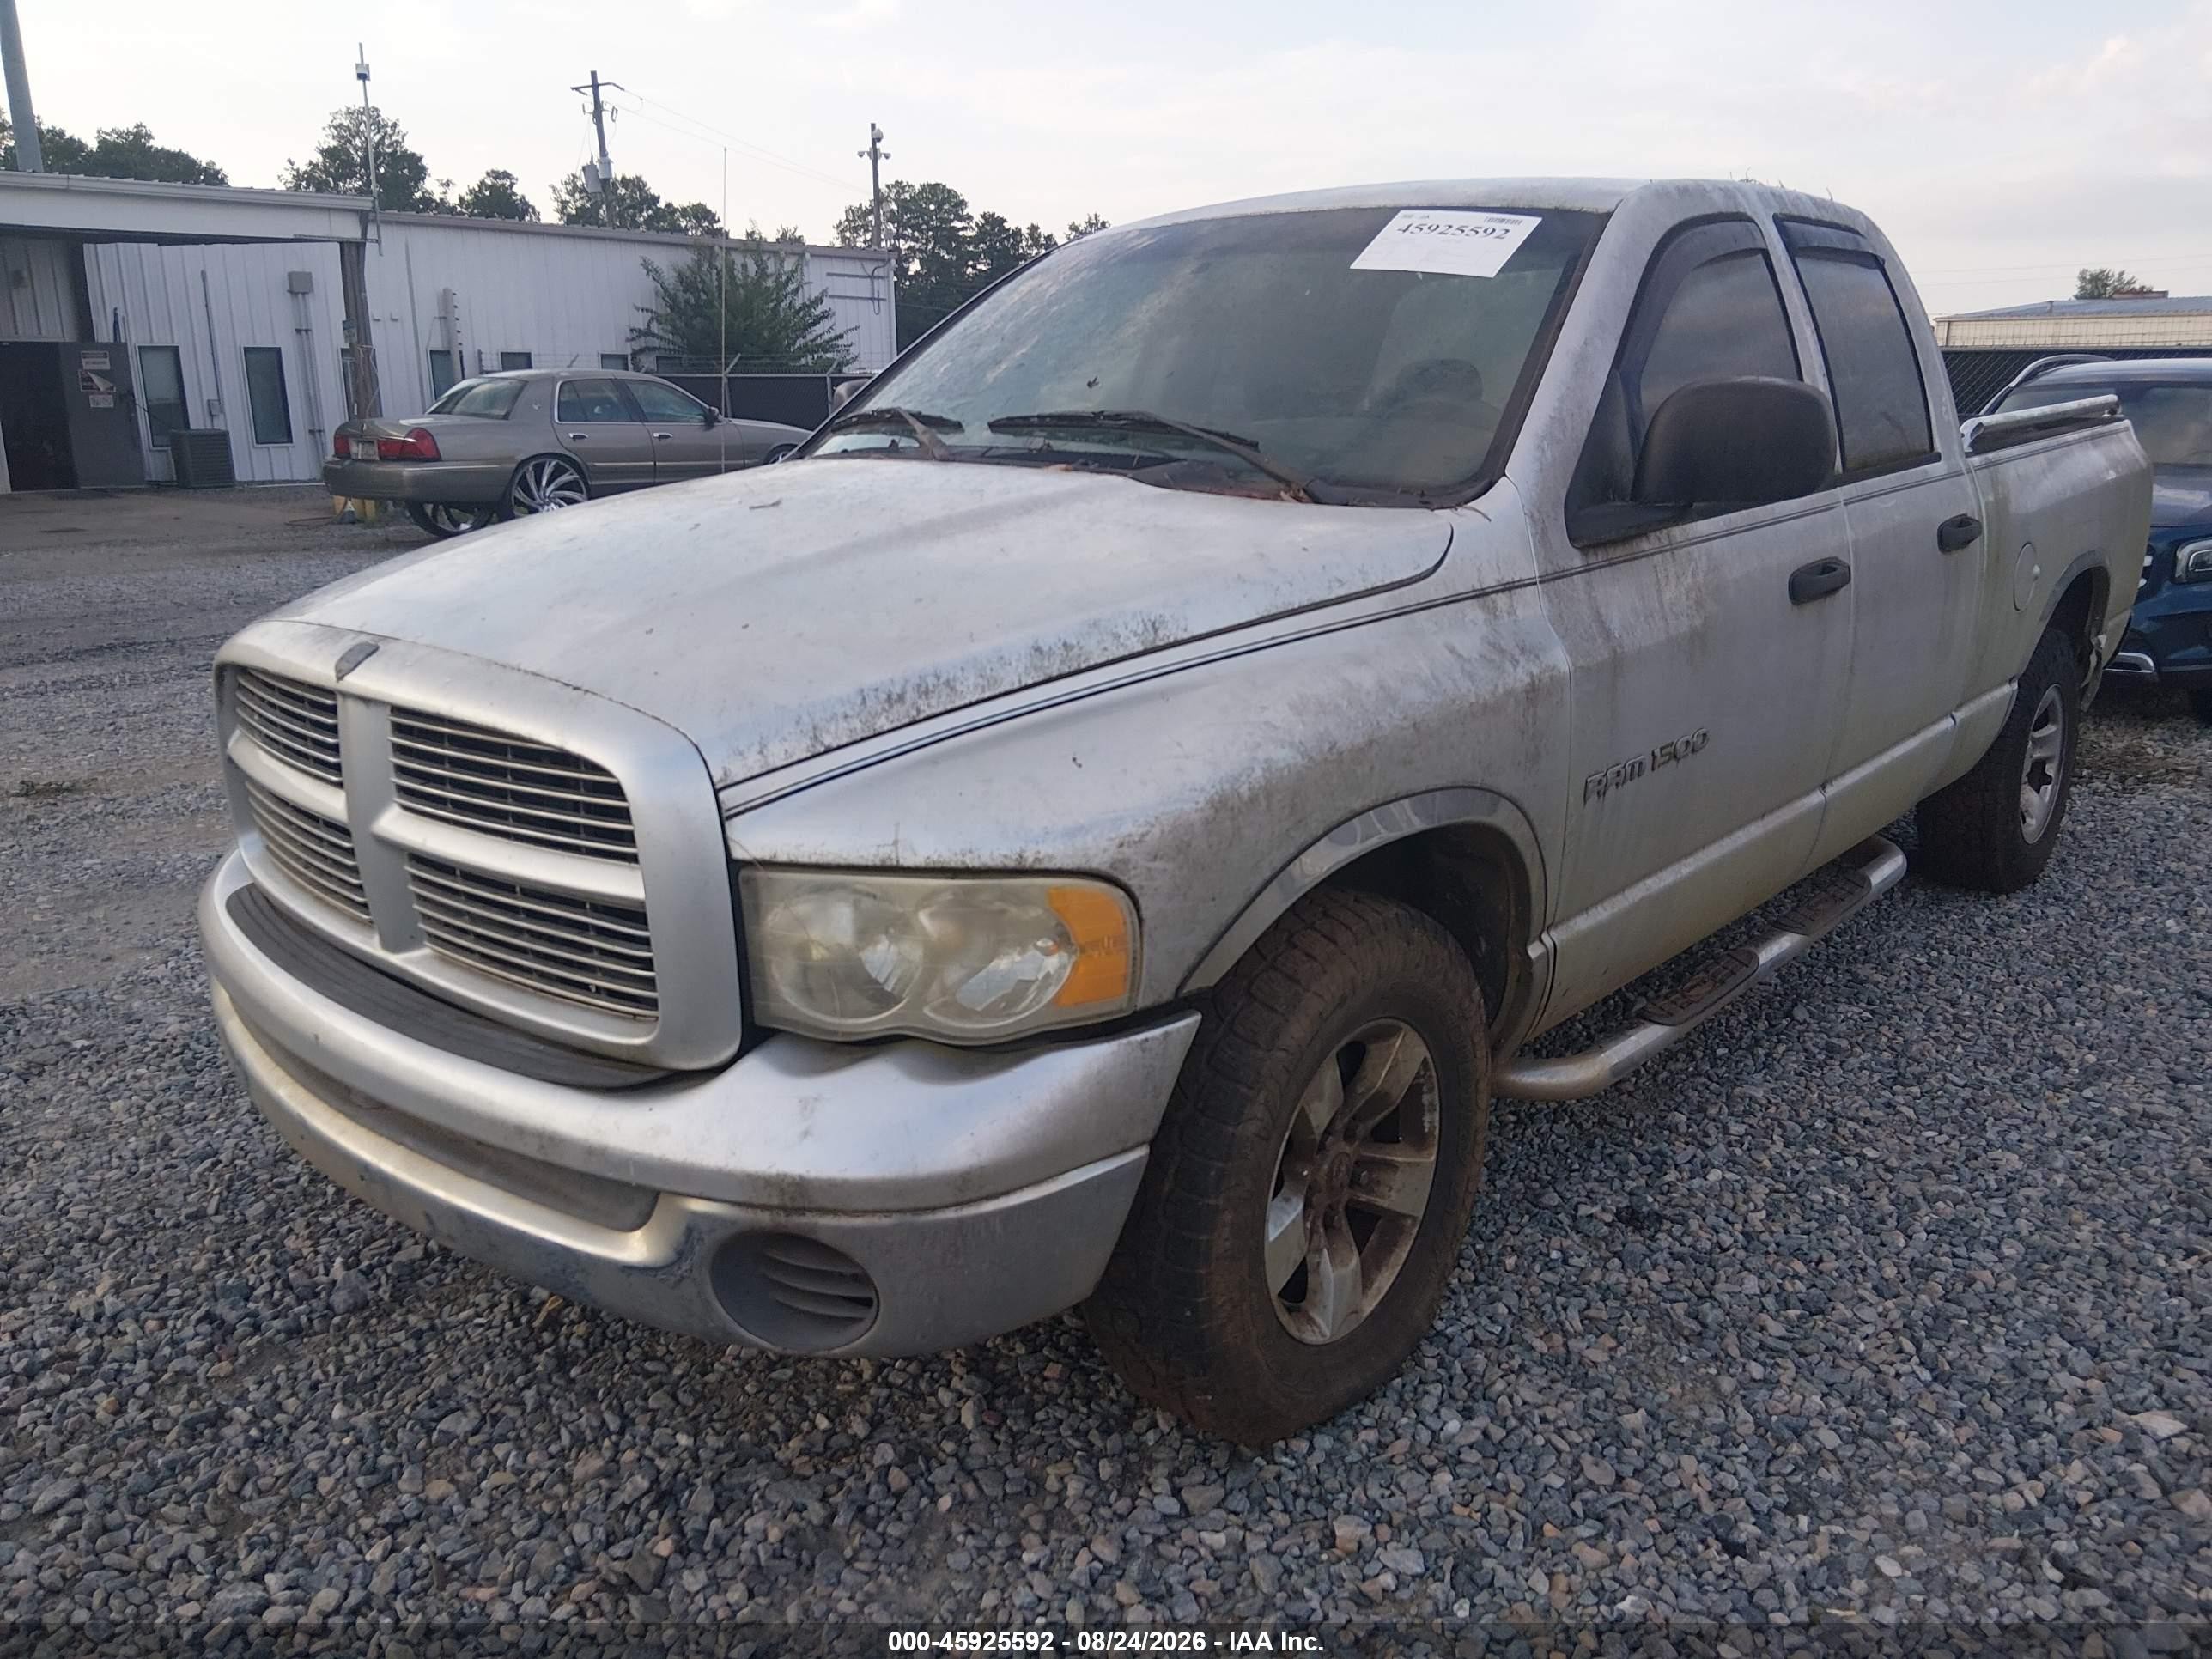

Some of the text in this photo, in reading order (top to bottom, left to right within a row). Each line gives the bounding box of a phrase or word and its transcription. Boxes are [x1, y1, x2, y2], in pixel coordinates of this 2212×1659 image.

[1398, 222, 1510, 239] 45925592
[1583, 728, 1710, 804] RAM 1500
